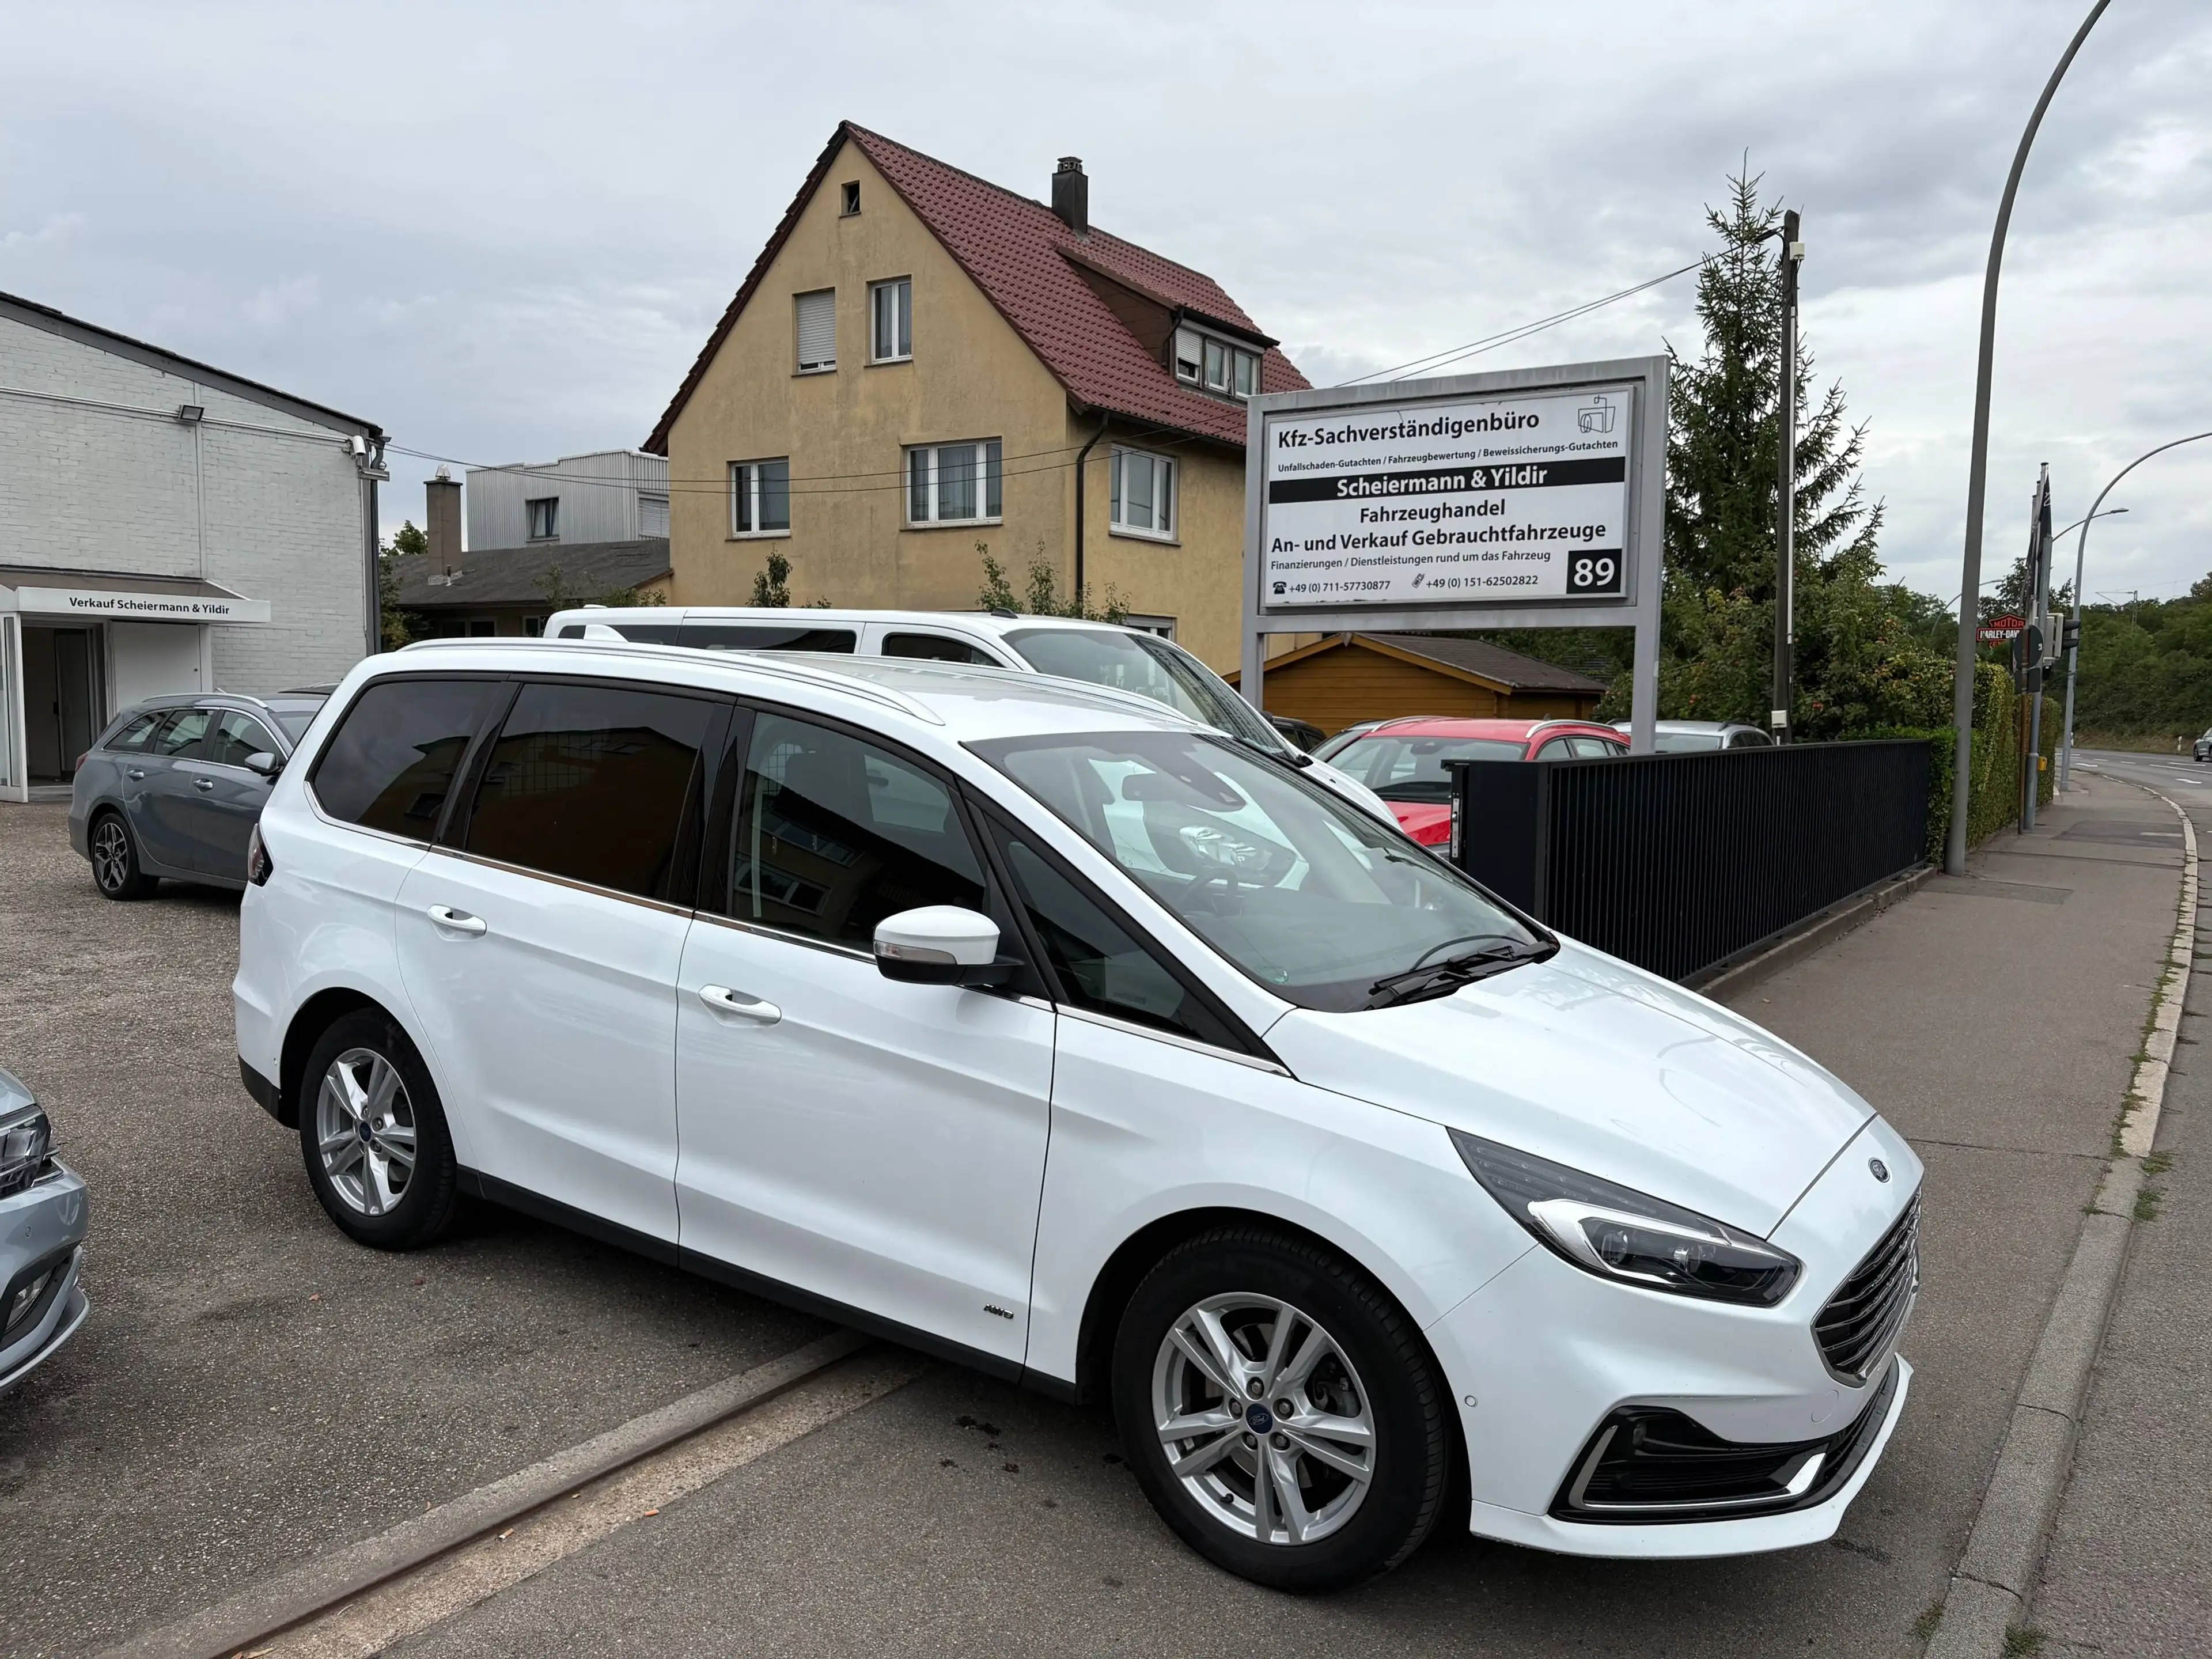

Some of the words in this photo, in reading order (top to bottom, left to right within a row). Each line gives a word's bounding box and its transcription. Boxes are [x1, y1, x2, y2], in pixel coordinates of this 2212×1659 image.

[1278, 411, 1539, 449] Kfz-Sachverständigenbüro
[1278, 457, 1381, 472] Unfallschaden-Gutachten
[1382, 456, 1387, 465] /
[1388, 451, 1476, 464] Fahrzeugbewertung
[1478, 449, 1482, 458] /
[1483, 440, 1618, 457] Beweissicherungs-Gutachten
[1337, 475, 1465, 497] Scheiermann
[1471, 469, 1487, 488] &
[1490, 465, 1548, 487] Yildir
[1360, 499, 1505, 523] Fahrzeughandel
[1271, 537, 1300, 553] An-
[1304, 534, 1336, 551] und
[1340, 530, 1408, 550] Verkauf
[1412, 524, 1606, 546] Gebrauchtfahrzeuge
[1271, 559, 1343, 570] Finanzierungen
[1344, 557, 1349, 568] /
[1350, 555, 1433, 567] Dienstleistungen
[1435, 552, 1460, 563] rund
[1462, 554, 1479, 562] um
[1481, 551, 1499, 561] das
[1502, 550, 1551, 562] Fahrzeug
[1573, 557, 1615, 587] 89
[1289, 584, 1307, 593] +49
[1309, 583, 1321, 594] (0)
[1323, 580, 1391, 592] 711-57730877
[1426, 578, 1446, 588] +49
[1448, 577, 1461, 589] (0)
[1464, 575, 1539, 587] 151-62502822
[69, 597, 115, 609] Verkauf
[117, 600, 190, 612] Scheiermann
[192, 604, 200, 613] &
[202, 604, 230, 615] Yildir
